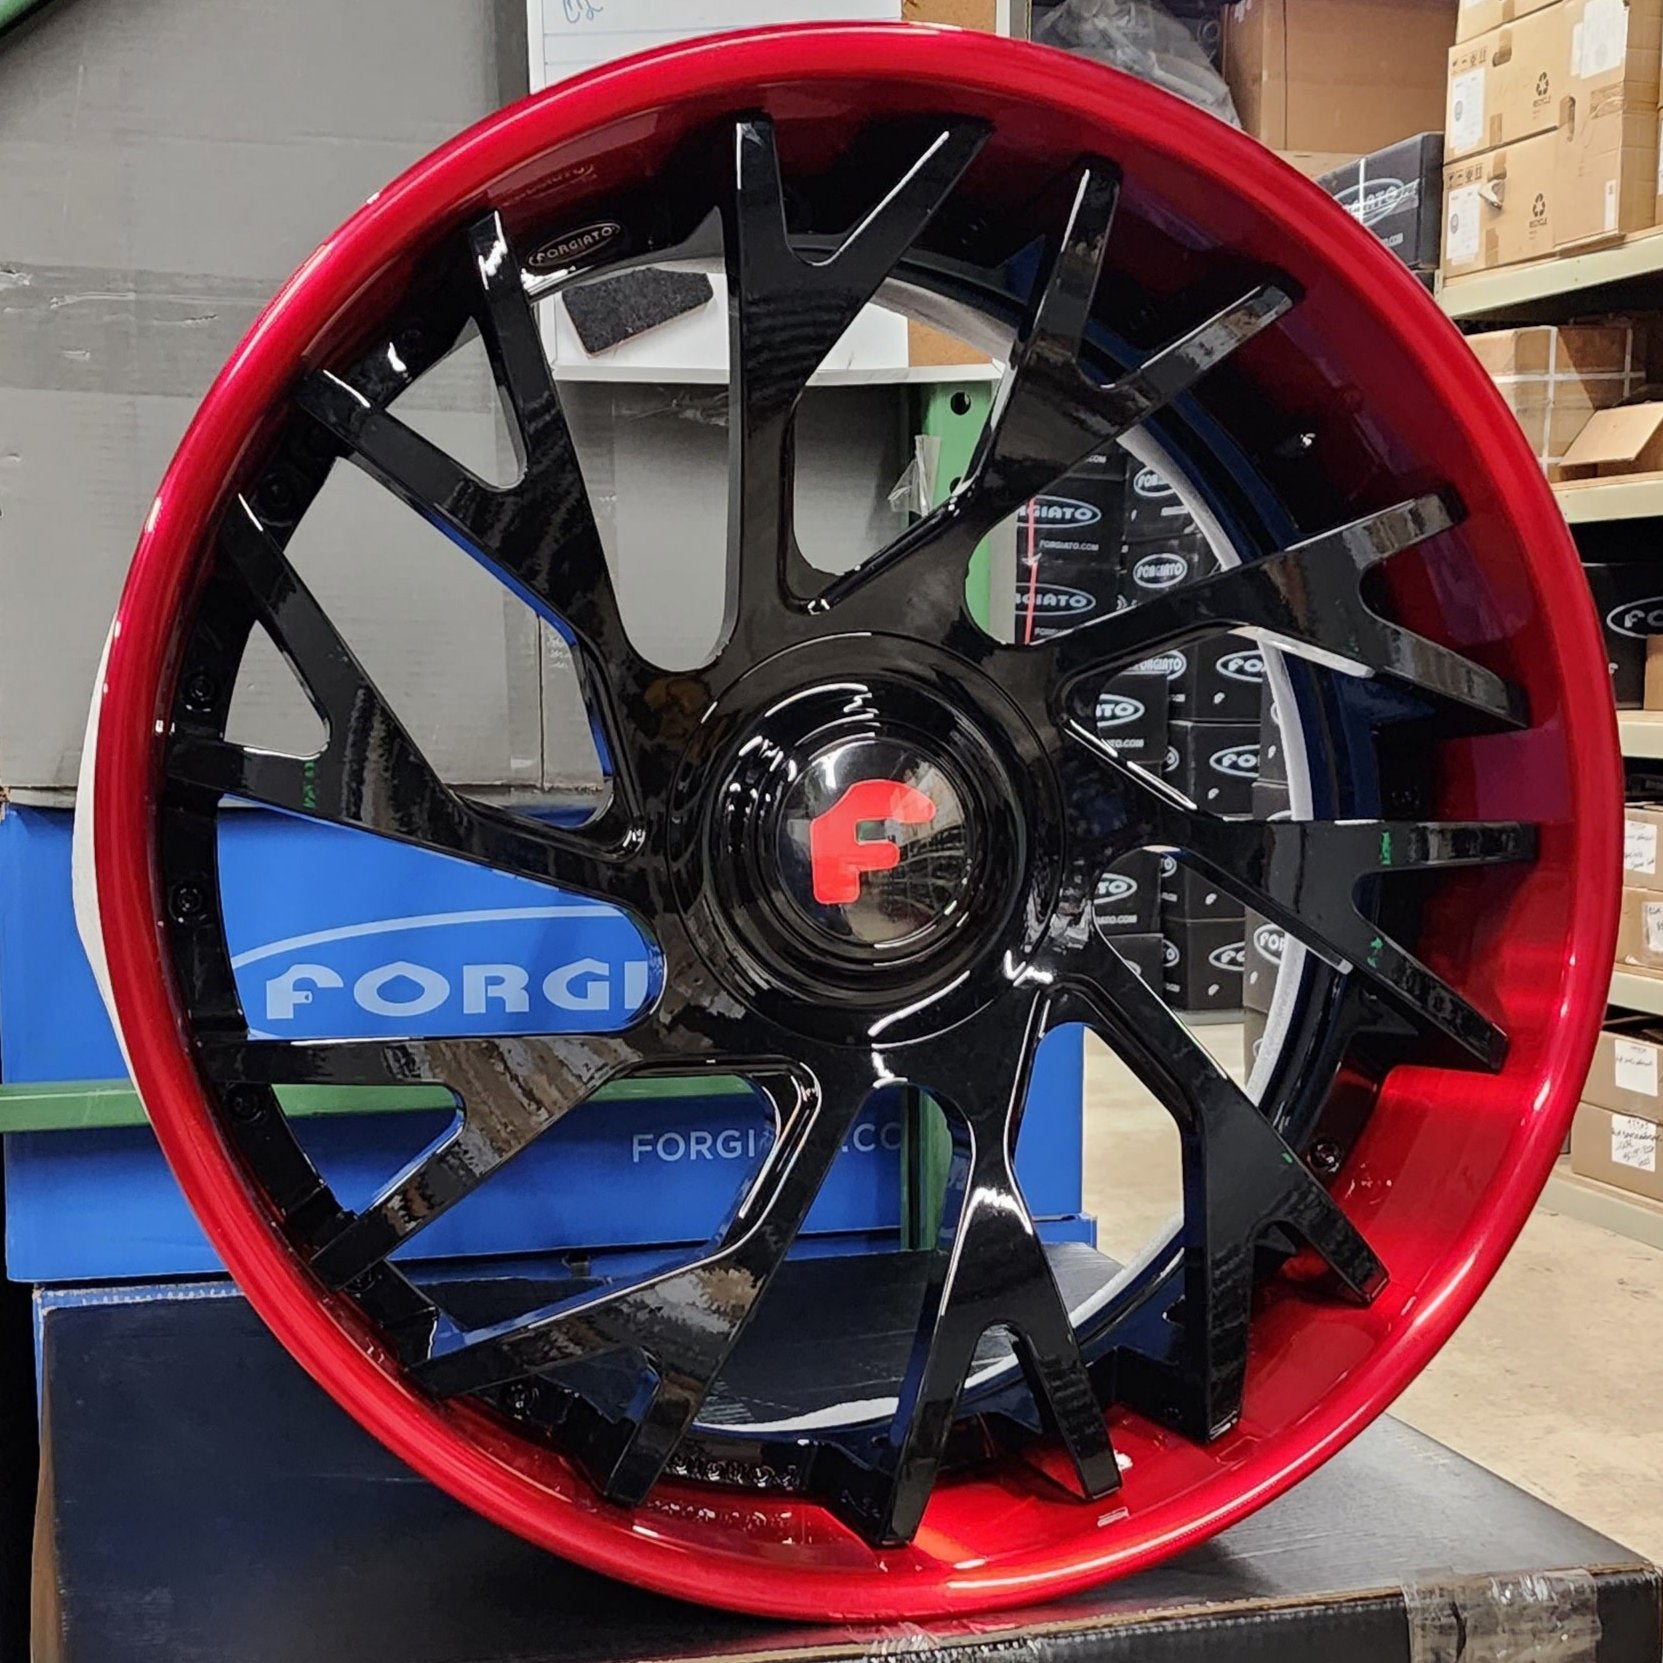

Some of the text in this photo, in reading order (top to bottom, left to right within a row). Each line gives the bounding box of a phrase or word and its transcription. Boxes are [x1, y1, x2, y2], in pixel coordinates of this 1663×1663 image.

[536, 226, 613, 264] FORGIATO
[1136, 563, 1183, 578] FORGIATO
[265, 960, 648, 1019] FORGI
